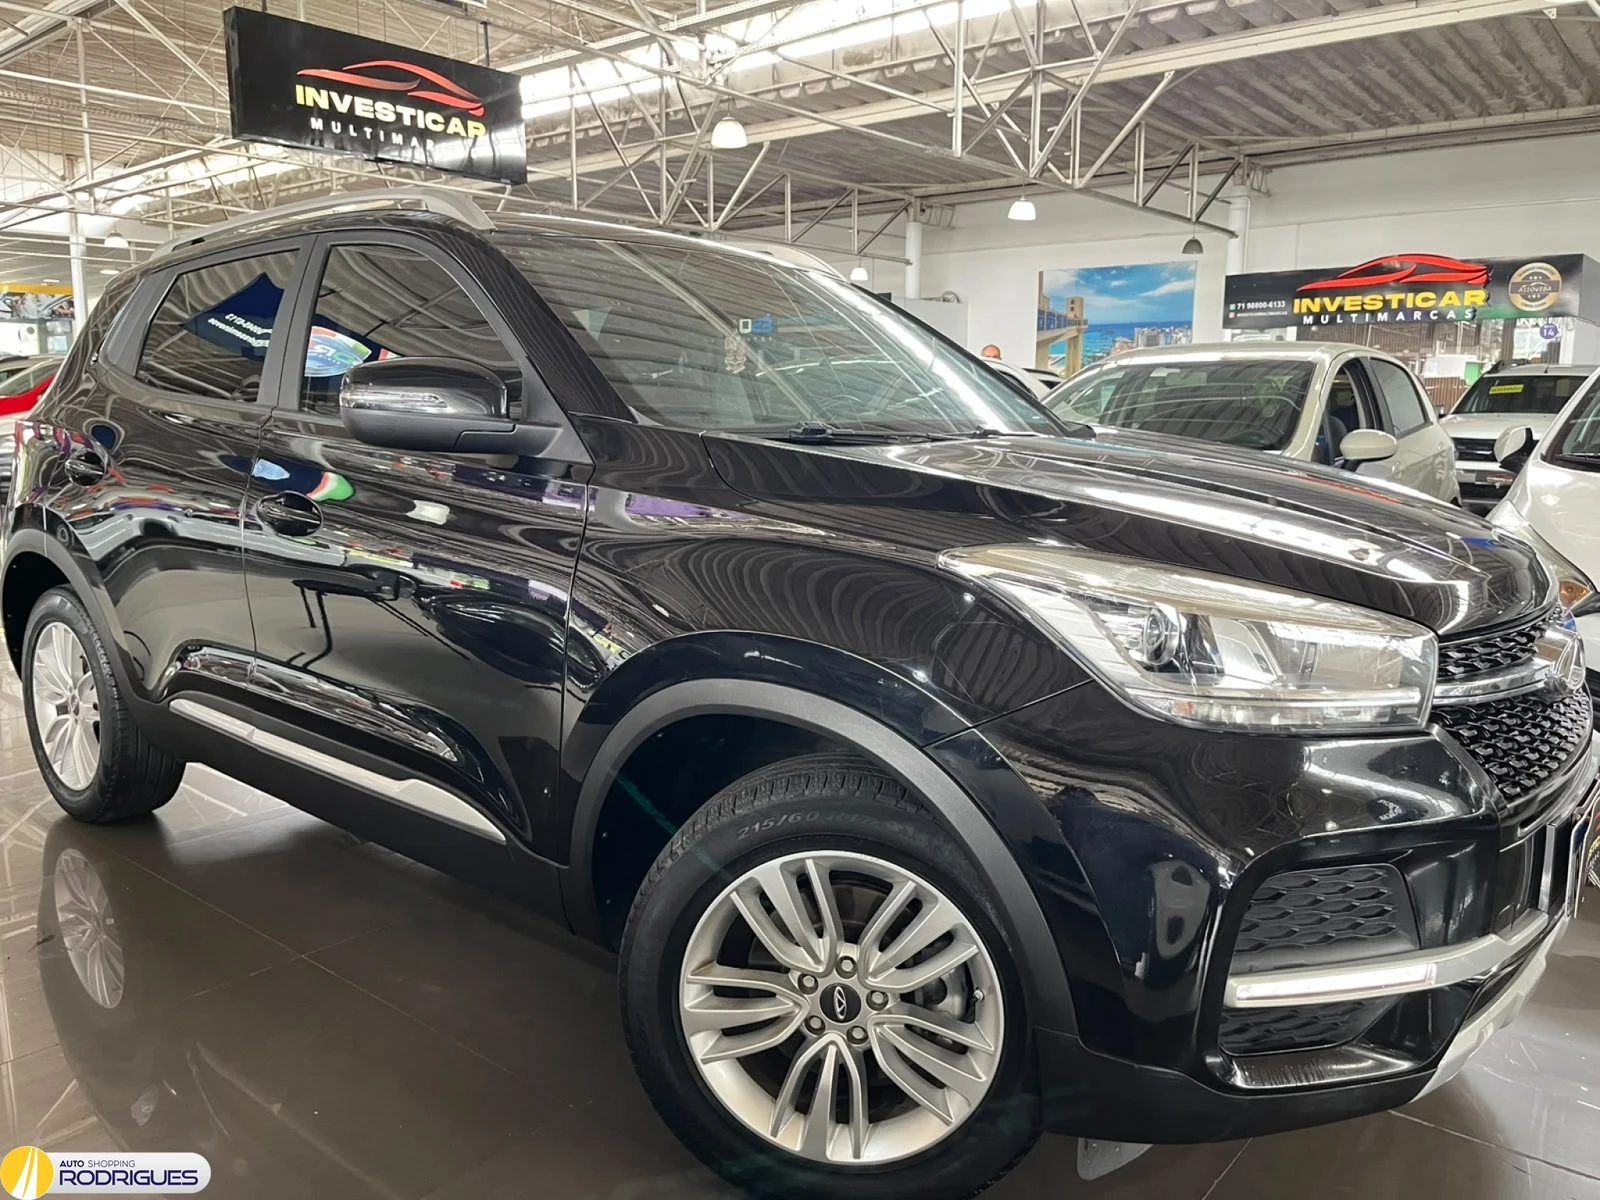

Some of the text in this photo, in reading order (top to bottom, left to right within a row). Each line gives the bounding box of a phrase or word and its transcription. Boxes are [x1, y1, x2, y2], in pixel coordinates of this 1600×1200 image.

[295, 84, 487, 139] INVESTICAR
[1237, 302, 1245, 310] 71
[1293, 289, 1488, 314] INVESTICAR
[1303, 308, 1474, 325] MULTIMARCAS
[1543, 328, 1555, 337] 14
[737, 811, 820, 841] 215/60
